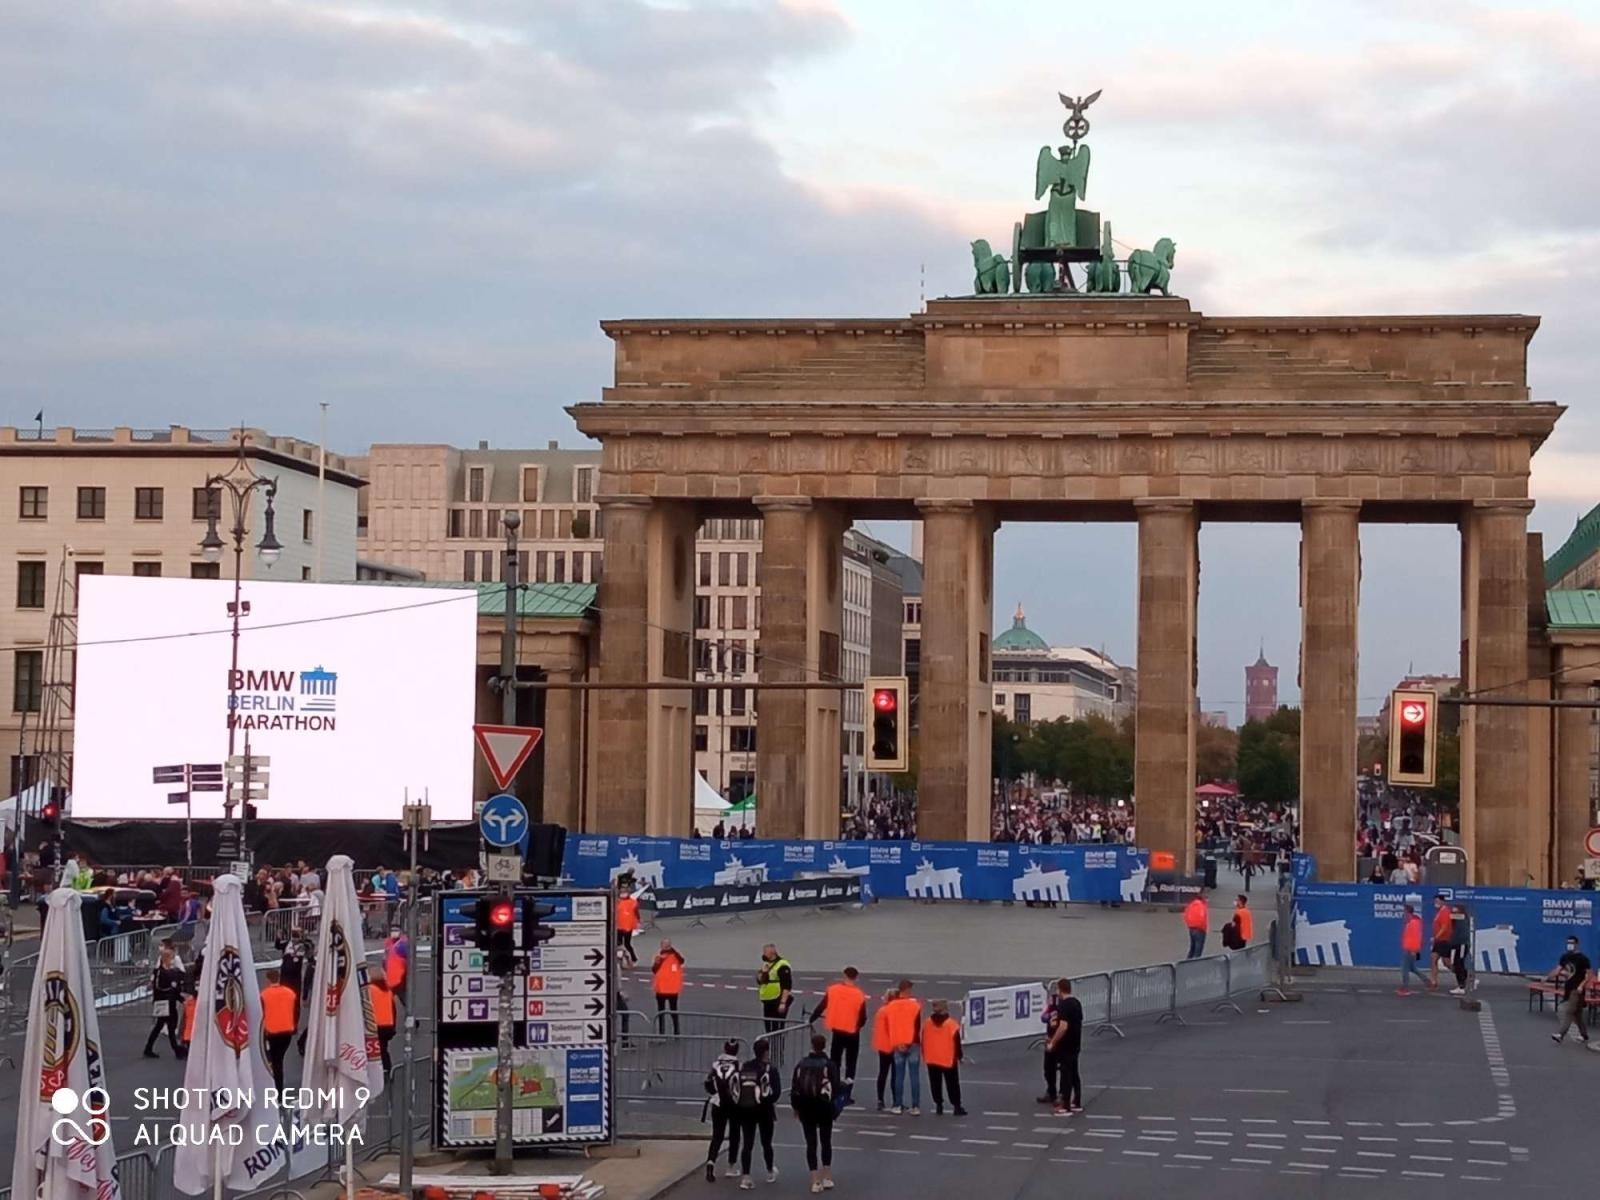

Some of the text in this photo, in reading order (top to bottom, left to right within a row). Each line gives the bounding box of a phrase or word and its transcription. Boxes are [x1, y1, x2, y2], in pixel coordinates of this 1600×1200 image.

[227, 669, 295, 692] BMW
[227, 694, 295, 711] BERLIN
[226, 713, 336, 731] MARATHON
[1373, 893, 1403, 902] BMW
[1542, 899, 1573, 908] BMW
[1542, 909, 1574, 917] BERLIN
[1542, 917, 1593, 926] MARATHON
